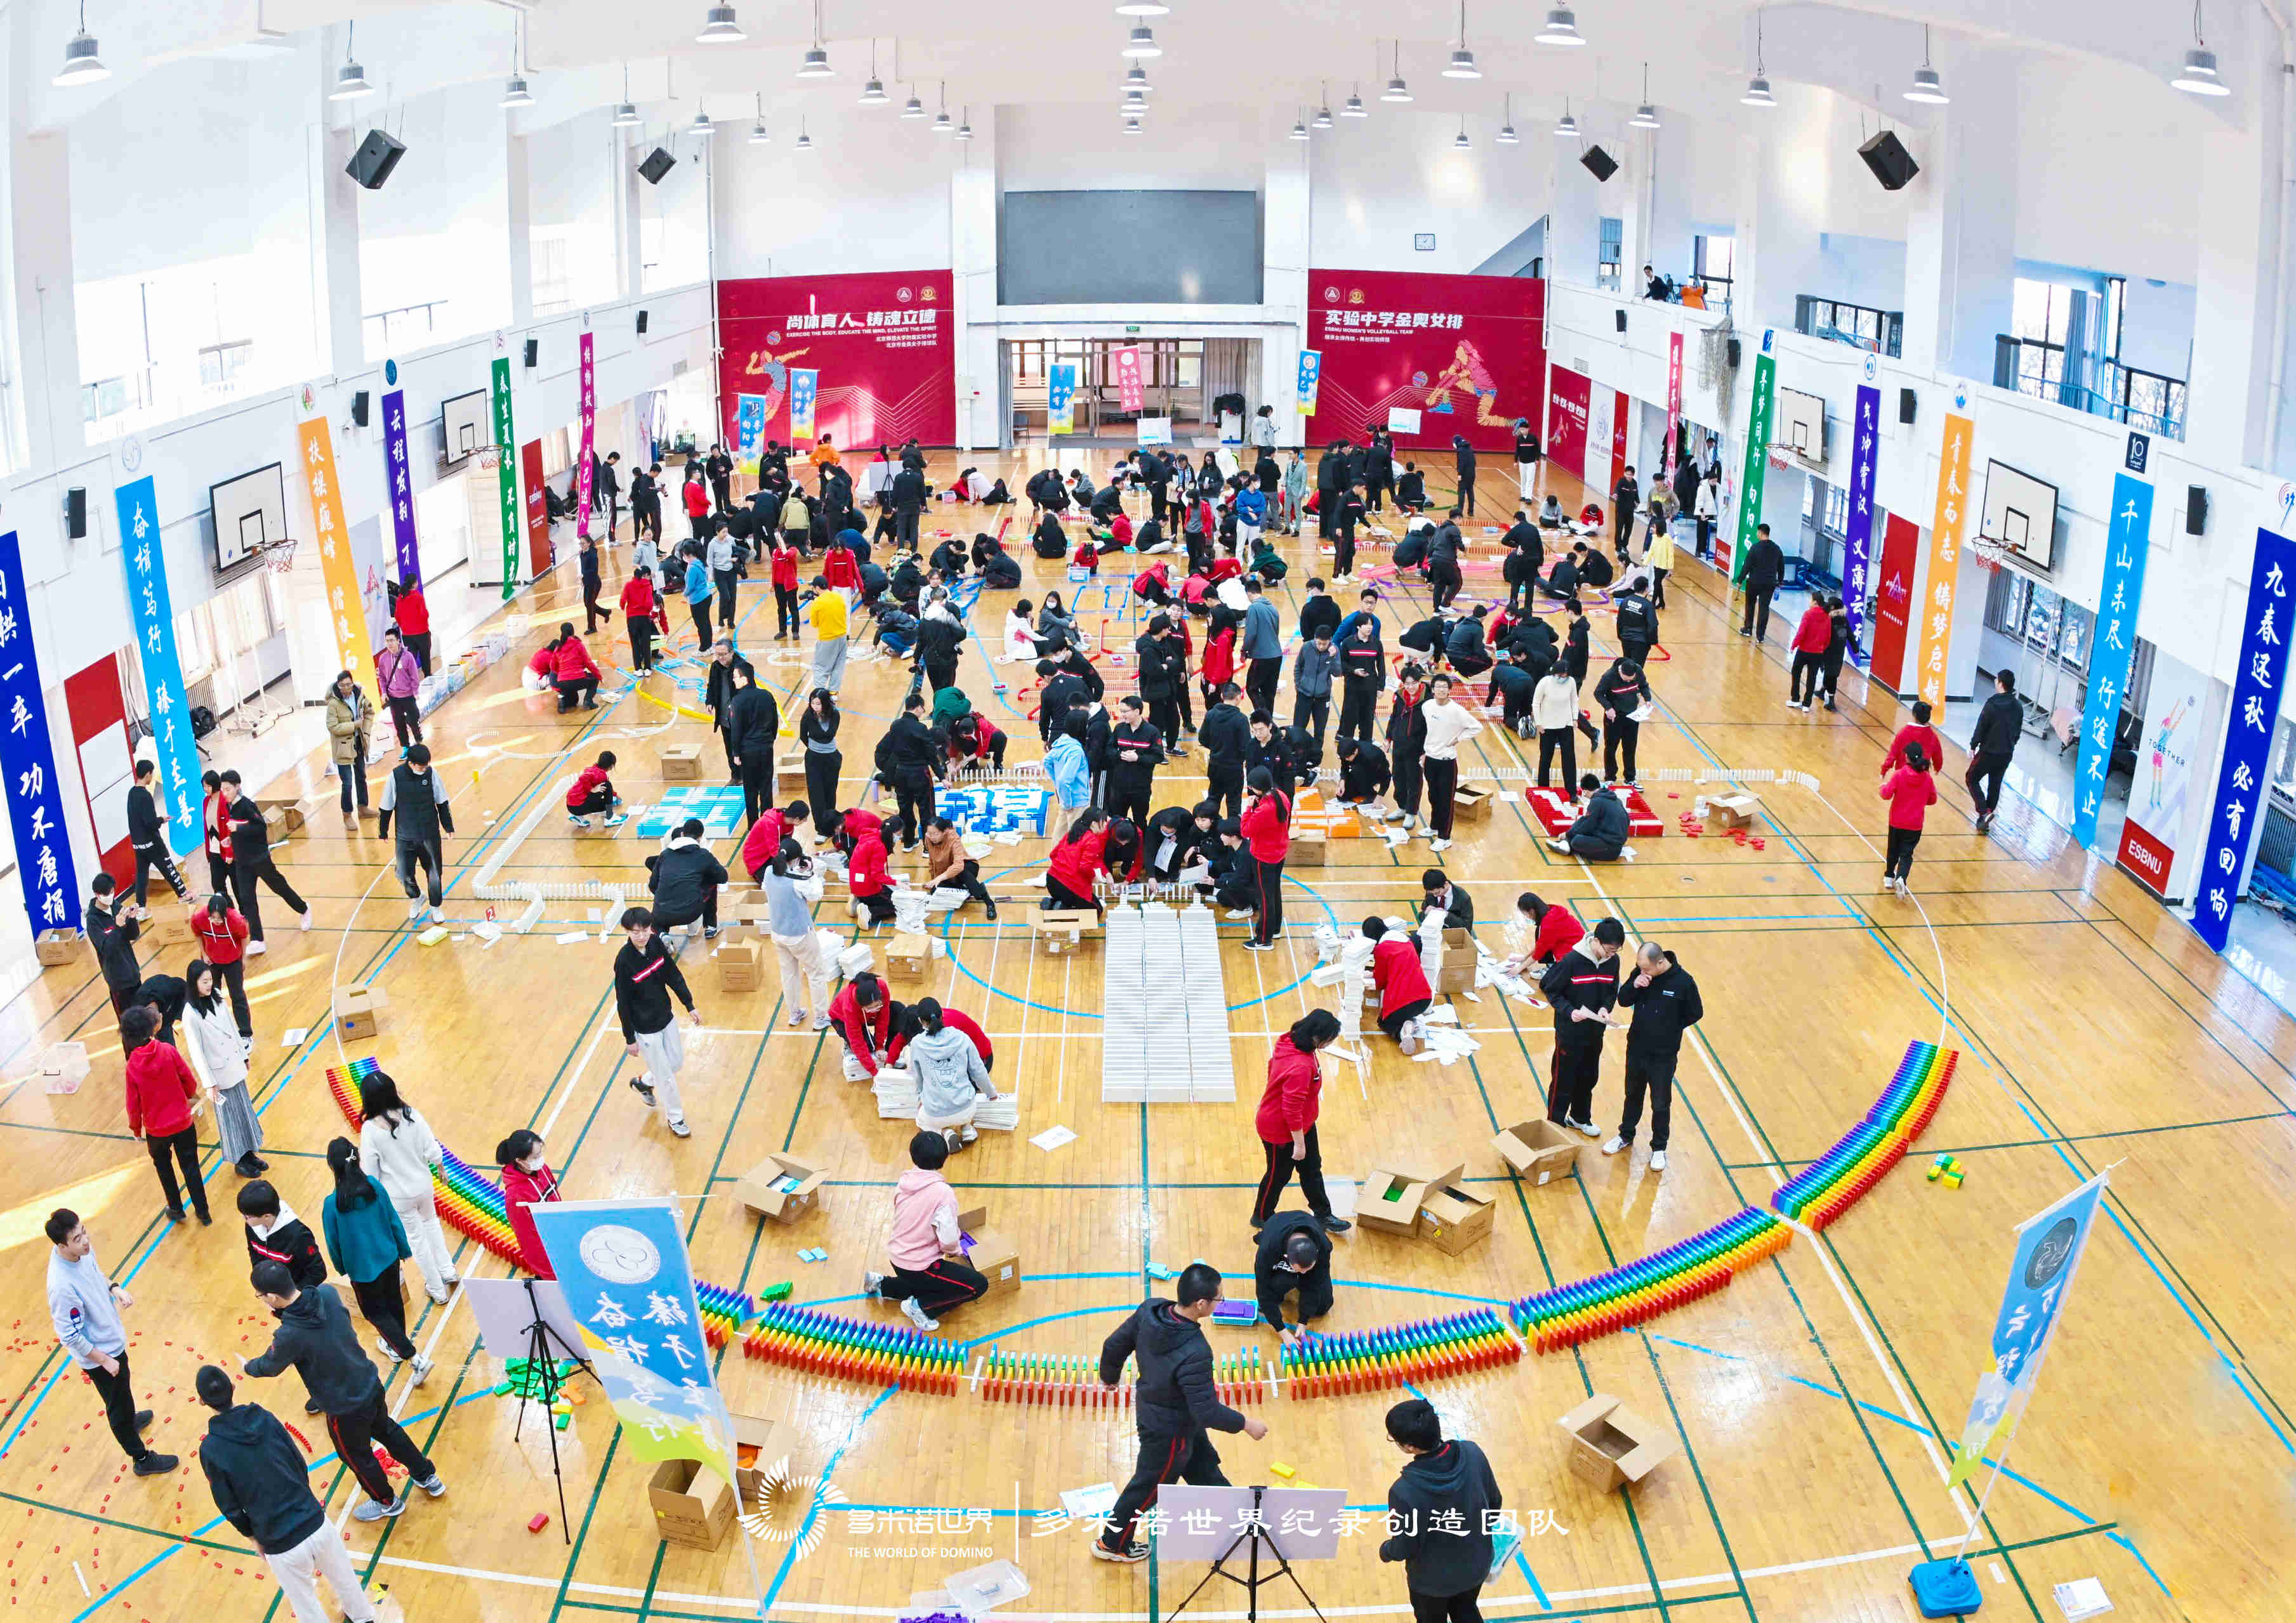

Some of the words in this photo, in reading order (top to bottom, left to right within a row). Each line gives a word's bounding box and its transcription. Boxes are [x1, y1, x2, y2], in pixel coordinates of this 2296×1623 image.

[1325, 310, 1463, 329] 实验中学金奥女排
[2103, 497, 2139, 650] 千山未尽
[132, 500, 162, 655] 奋楫笃行
[155, 678, 196, 829] 臻于至善
[2244, 561, 2287, 735] 九春还秋
[2082, 674, 2116, 818] 行途不止
[2148, 737, 2186, 767] TOGETHER
[20, 761, 66, 925] 功不唐捐
[487, 908, 494, 921] 2
[2128, 838, 2162, 876] ESBNU
[2209, 759, 2254, 923] 必有回响
